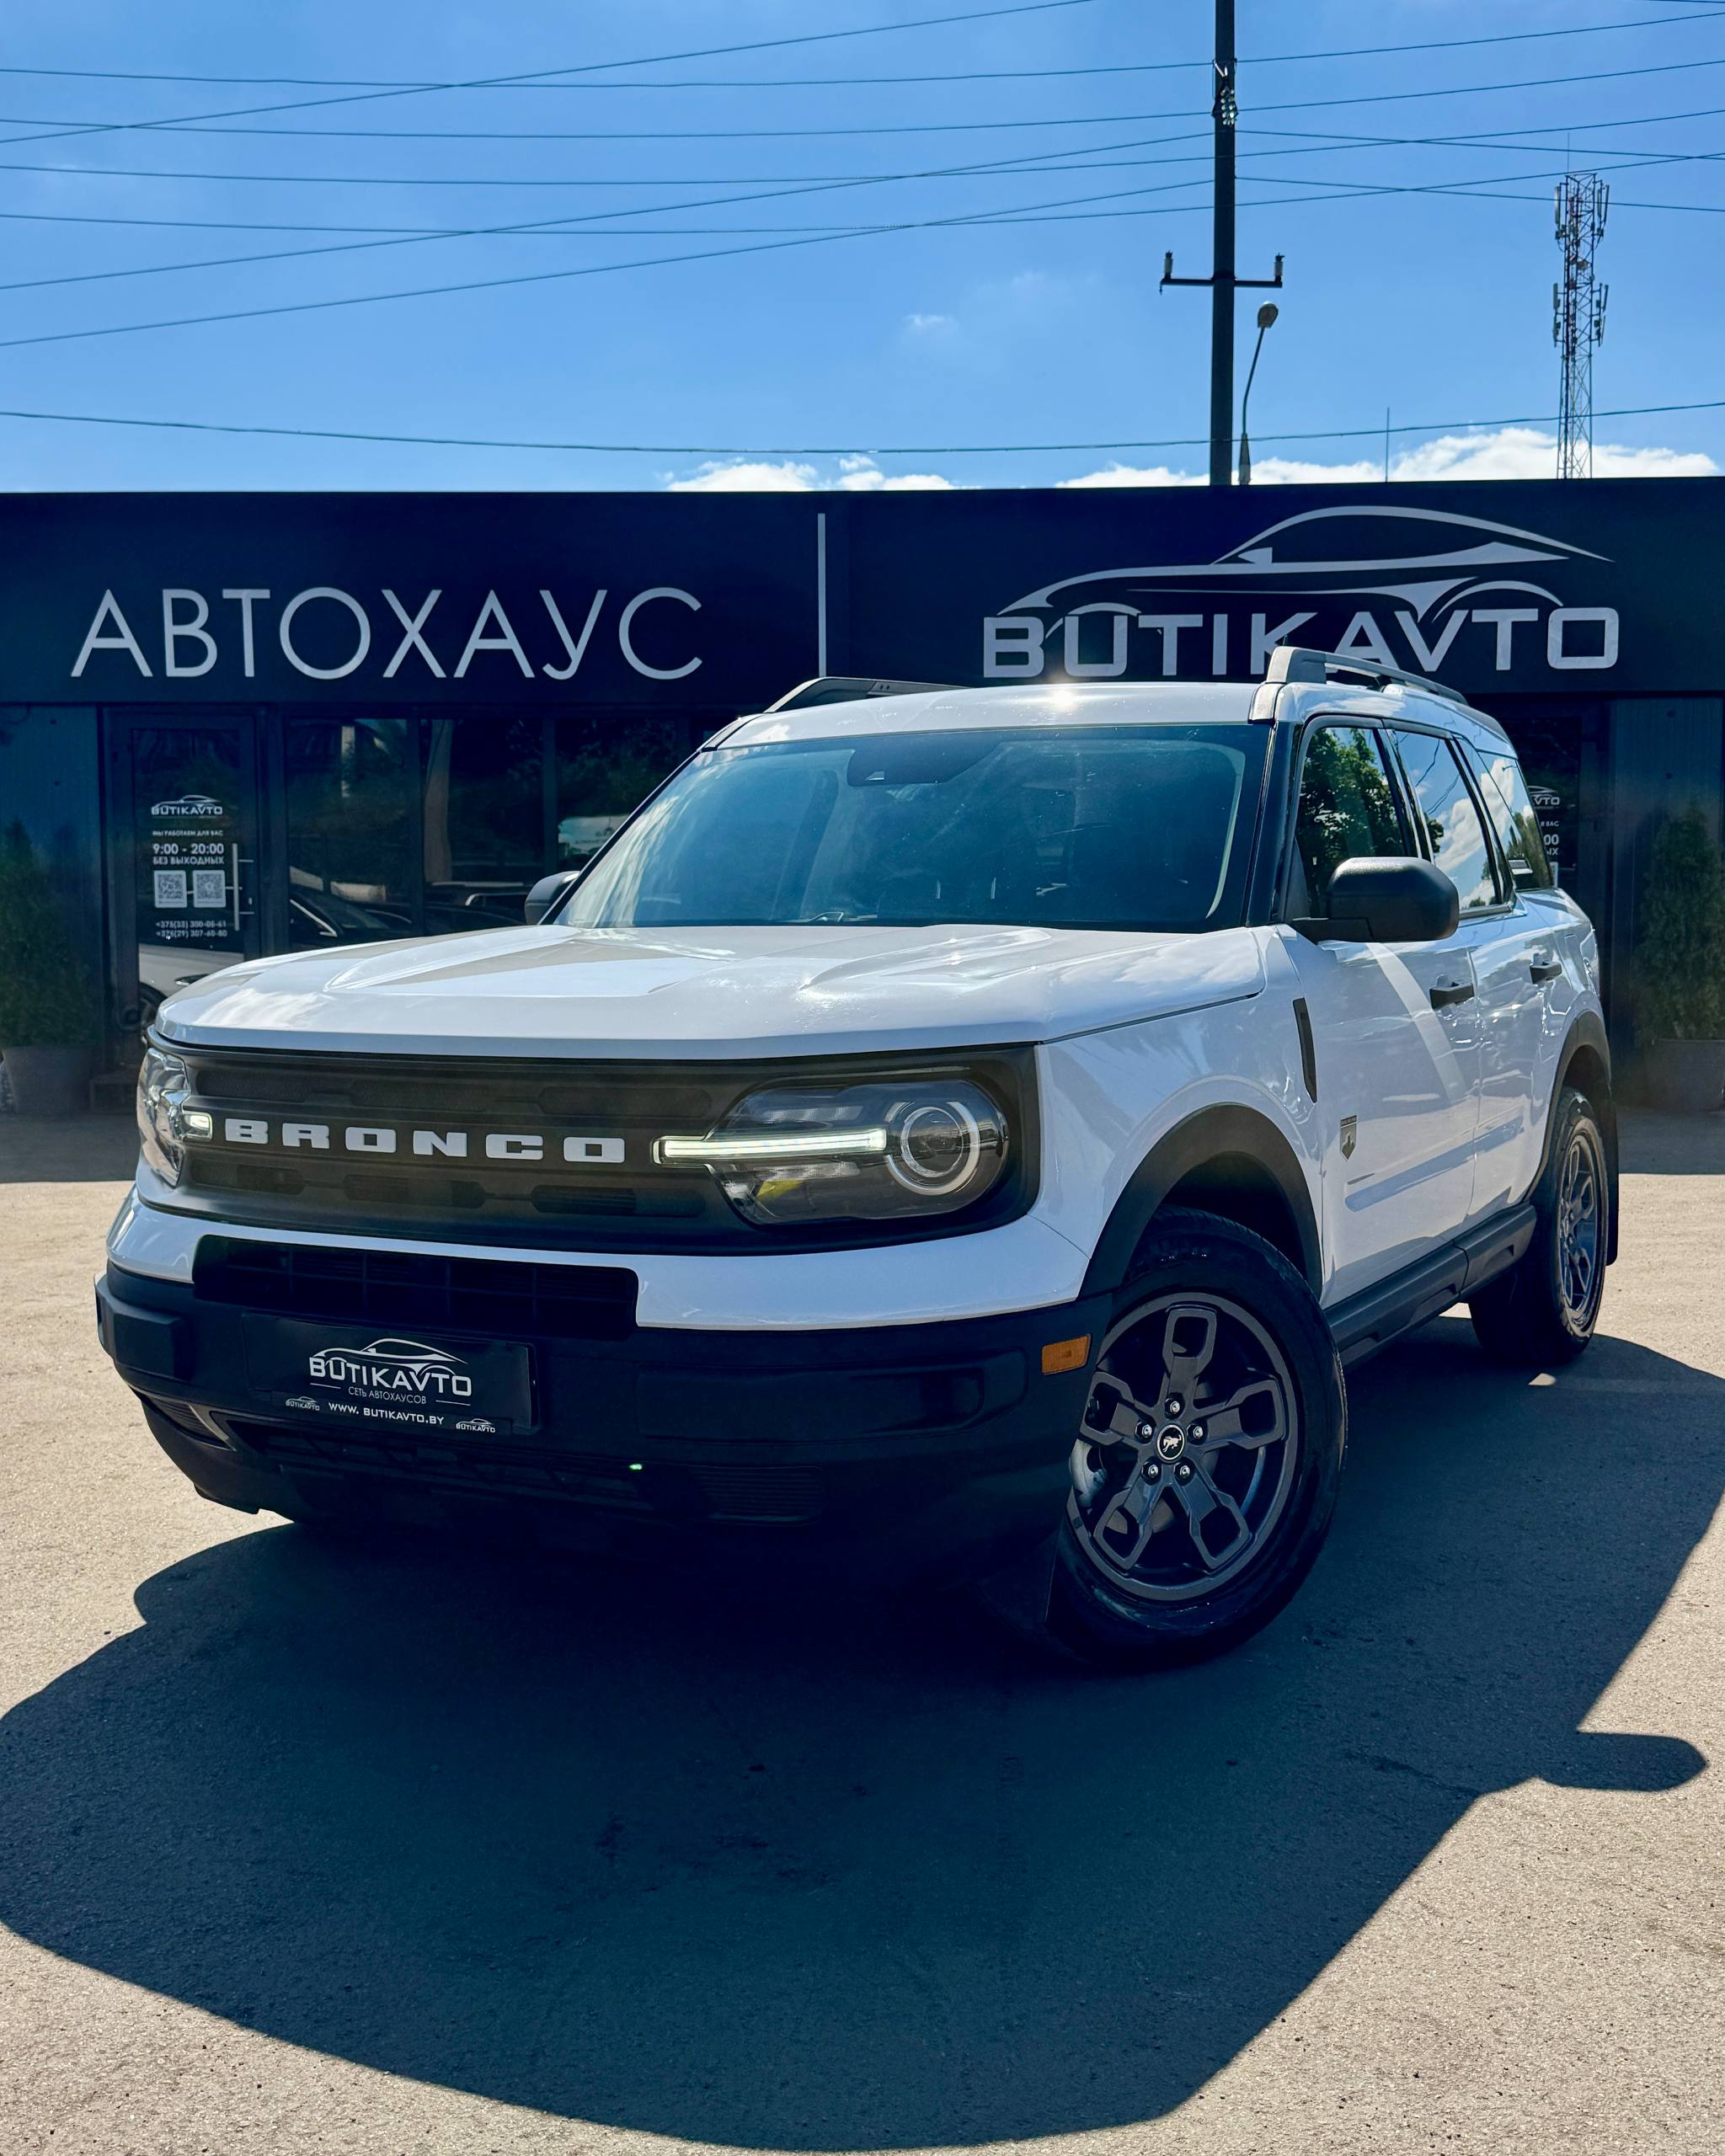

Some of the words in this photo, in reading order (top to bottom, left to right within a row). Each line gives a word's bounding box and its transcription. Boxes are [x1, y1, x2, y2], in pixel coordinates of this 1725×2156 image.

[71, 586, 703, 680] АВТОХАУС
[983, 606, 1620, 679] BUTIKAVTO
[151, 806, 223, 815] BUTIKAVTO
[153, 843, 179, 855] 9:00
[190, 843, 224, 855] 20:00
[153, 857, 168, 865] БЕЗ
[170, 857, 224, 865] ВЫХОДНЫХ
[224, 1117, 626, 1164] BRONCO
[309, 1357, 472, 1396] BUTIKAVTO
[348, 1386, 367, 1397] СЕТЬ
[368, 1390, 426, 1405] АВТОХАУСОВ
[328, 1402, 360, 1415] WWW.
[363, 1407, 444, 1425] BUTIKAVTO.BY
[456, 1422, 495, 1433] BUTIKAVTO
